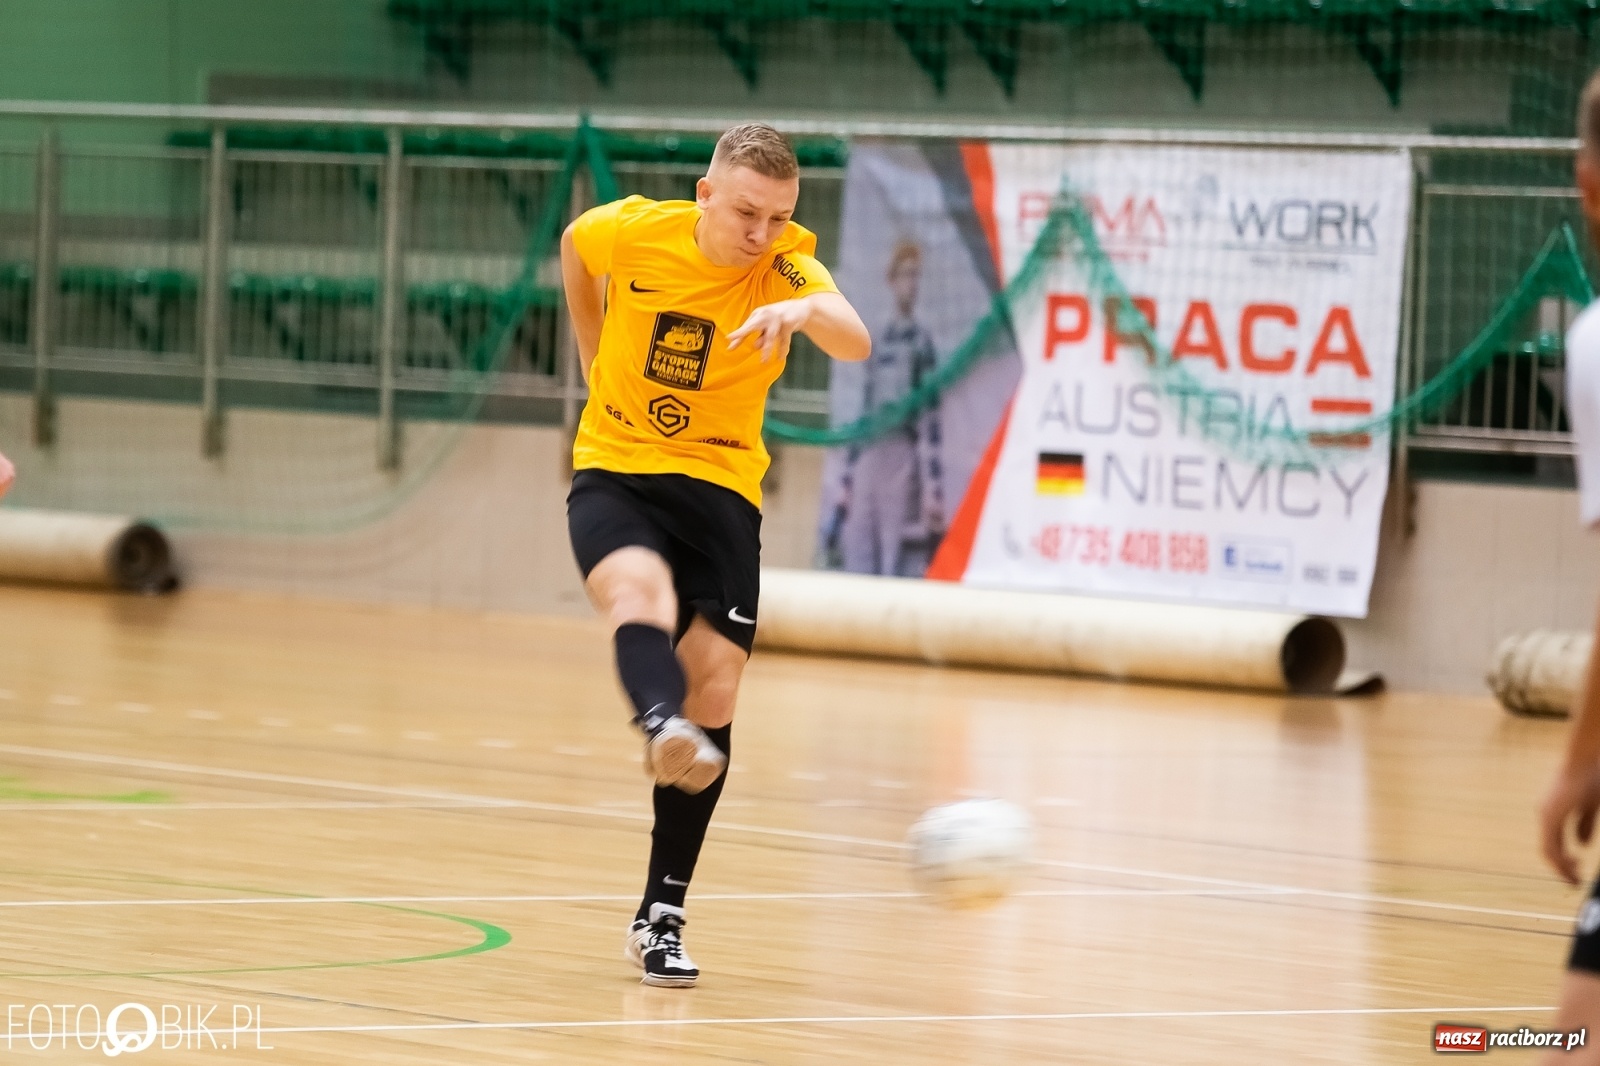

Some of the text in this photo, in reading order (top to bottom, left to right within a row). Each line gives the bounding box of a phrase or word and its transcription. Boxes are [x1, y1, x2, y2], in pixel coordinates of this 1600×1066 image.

[1229, 198, 1379, 247] WORK
[654, 350, 700, 370] STOPIW
[1043, 293, 1372, 379] PRACA
[651, 360, 698, 382] GARAGE
[1037, 381, 1301, 443] AUSTRIA
[1100, 451, 1371, 520] NIEMCY
